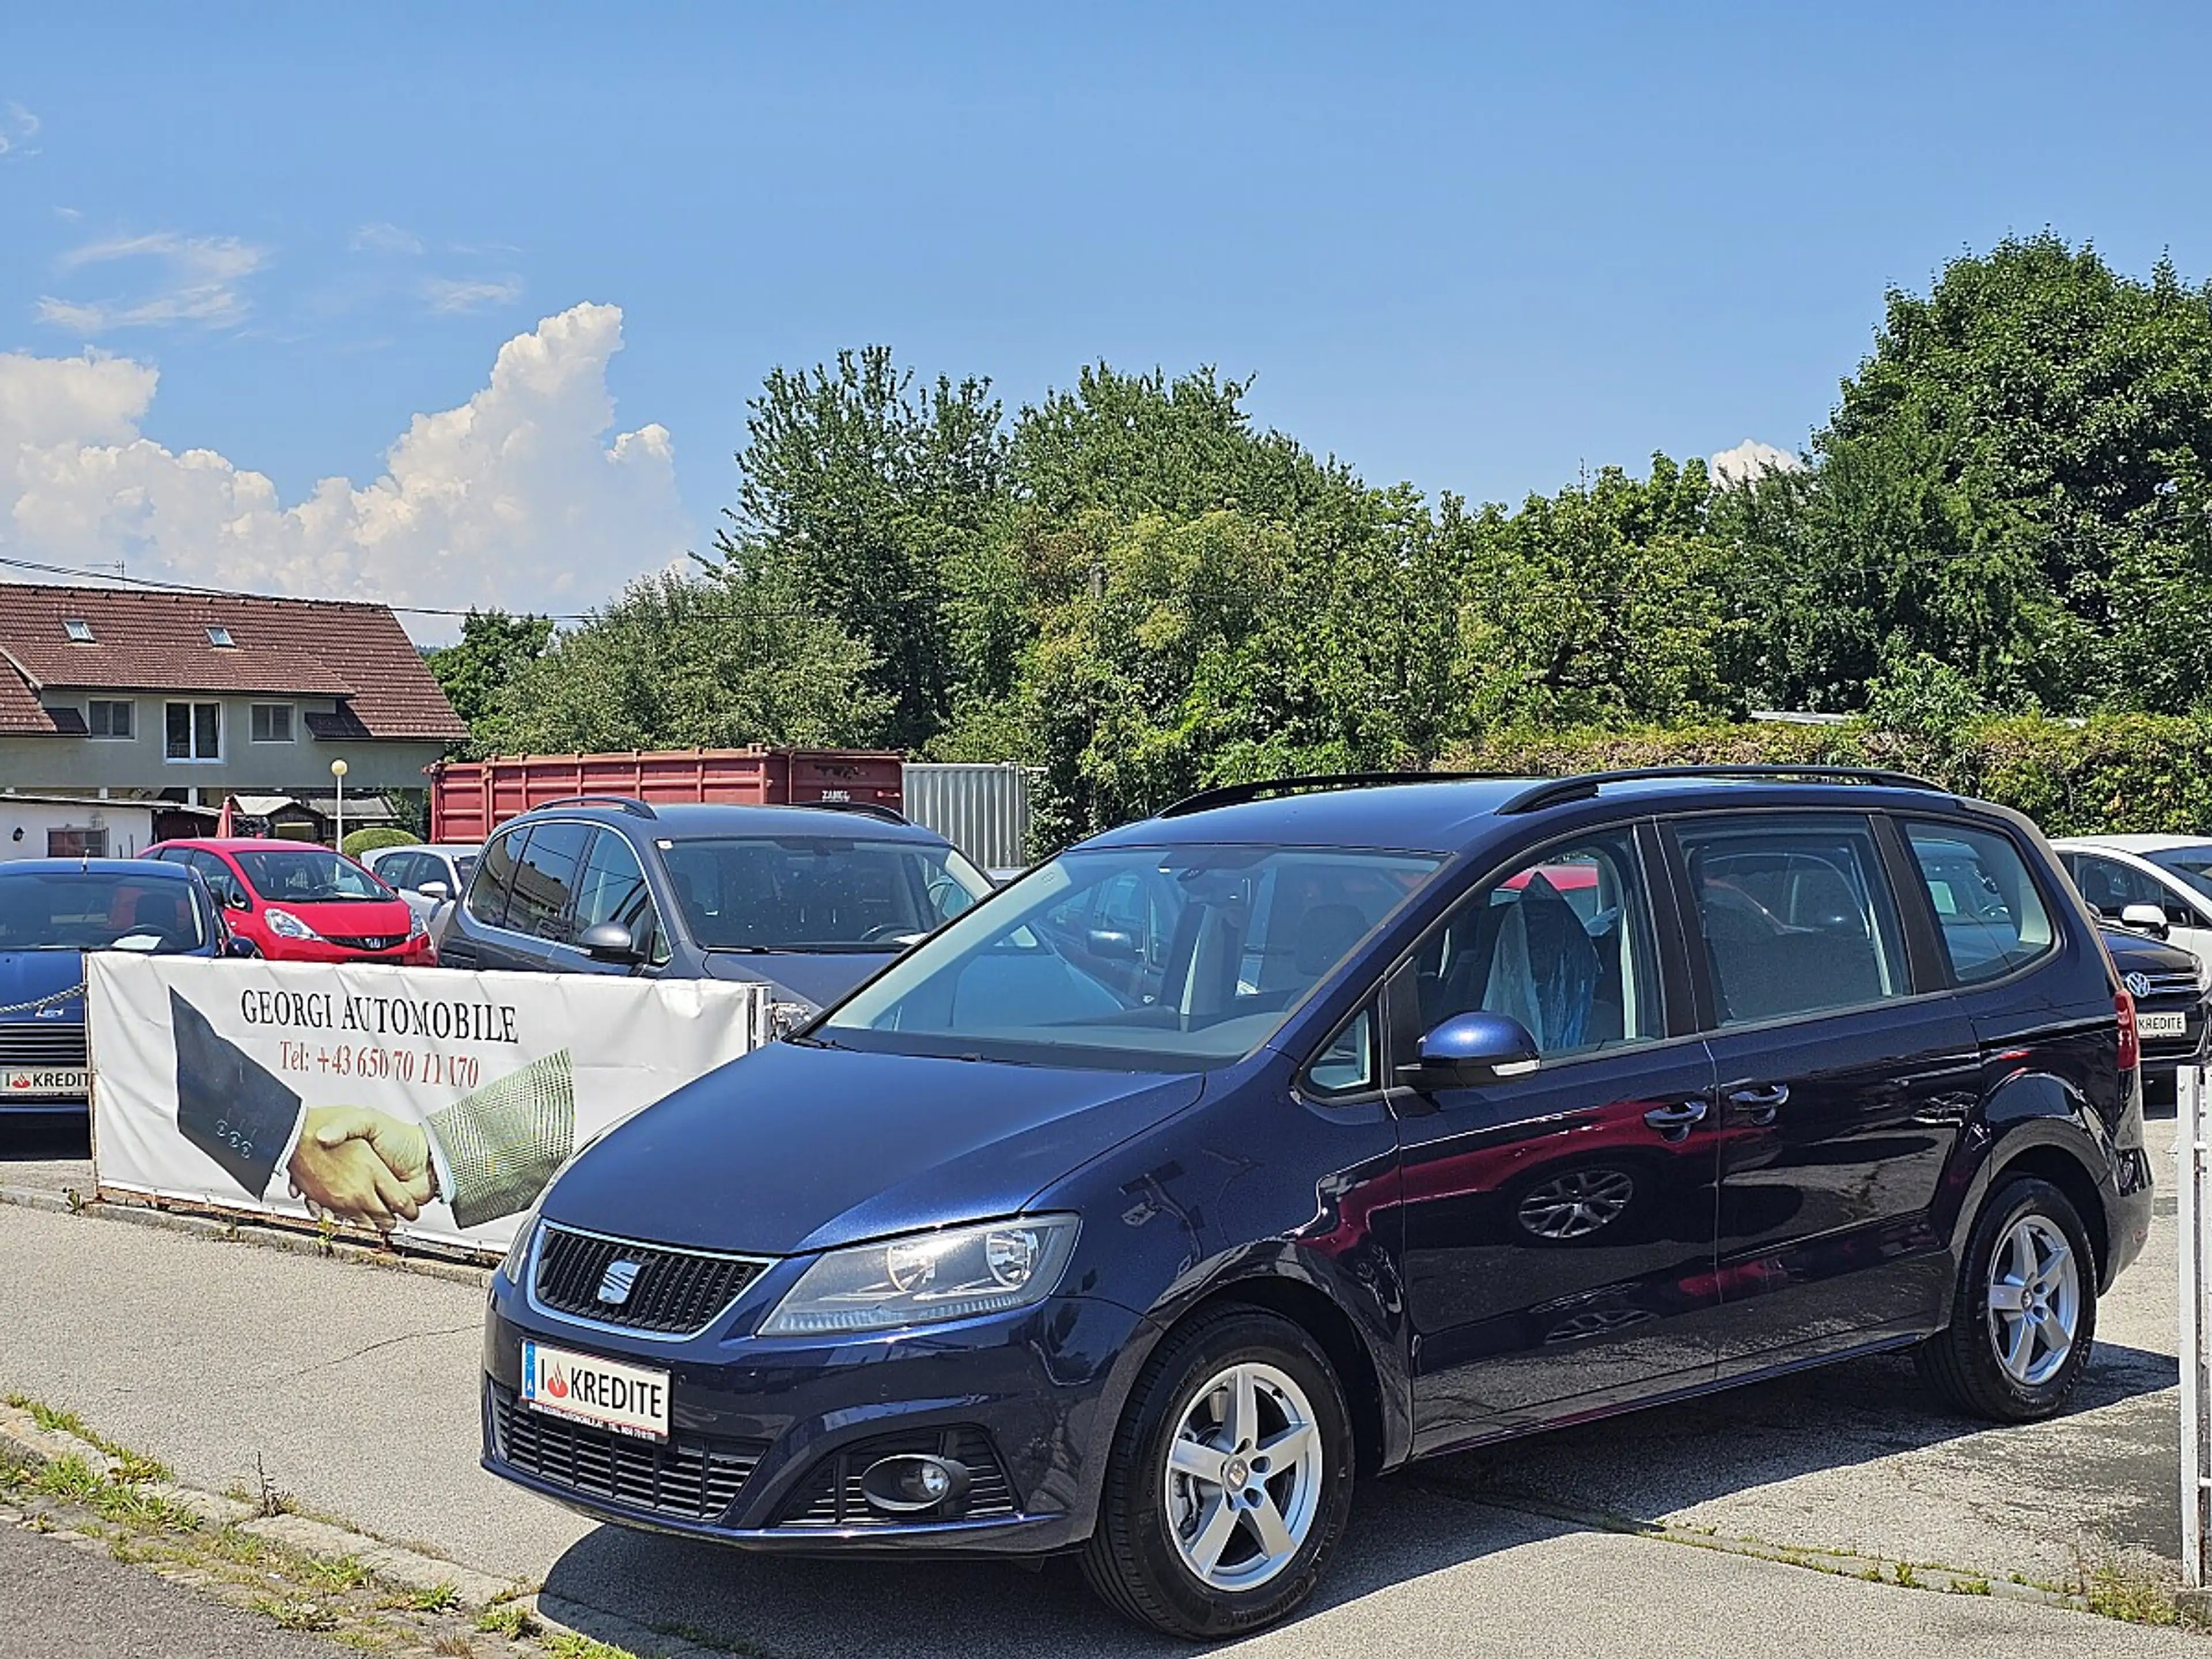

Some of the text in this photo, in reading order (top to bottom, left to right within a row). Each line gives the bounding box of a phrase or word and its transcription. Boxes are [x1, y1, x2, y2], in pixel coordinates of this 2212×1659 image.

[241, 989, 518, 1044] GEORGI AUTOMOBILE
[2138, 1017, 2182, 1030] KREDITE
[279, 1041, 479, 1089] Tel: +43 650 70 11 170
[570, 1367, 663, 1418] KREDITE
